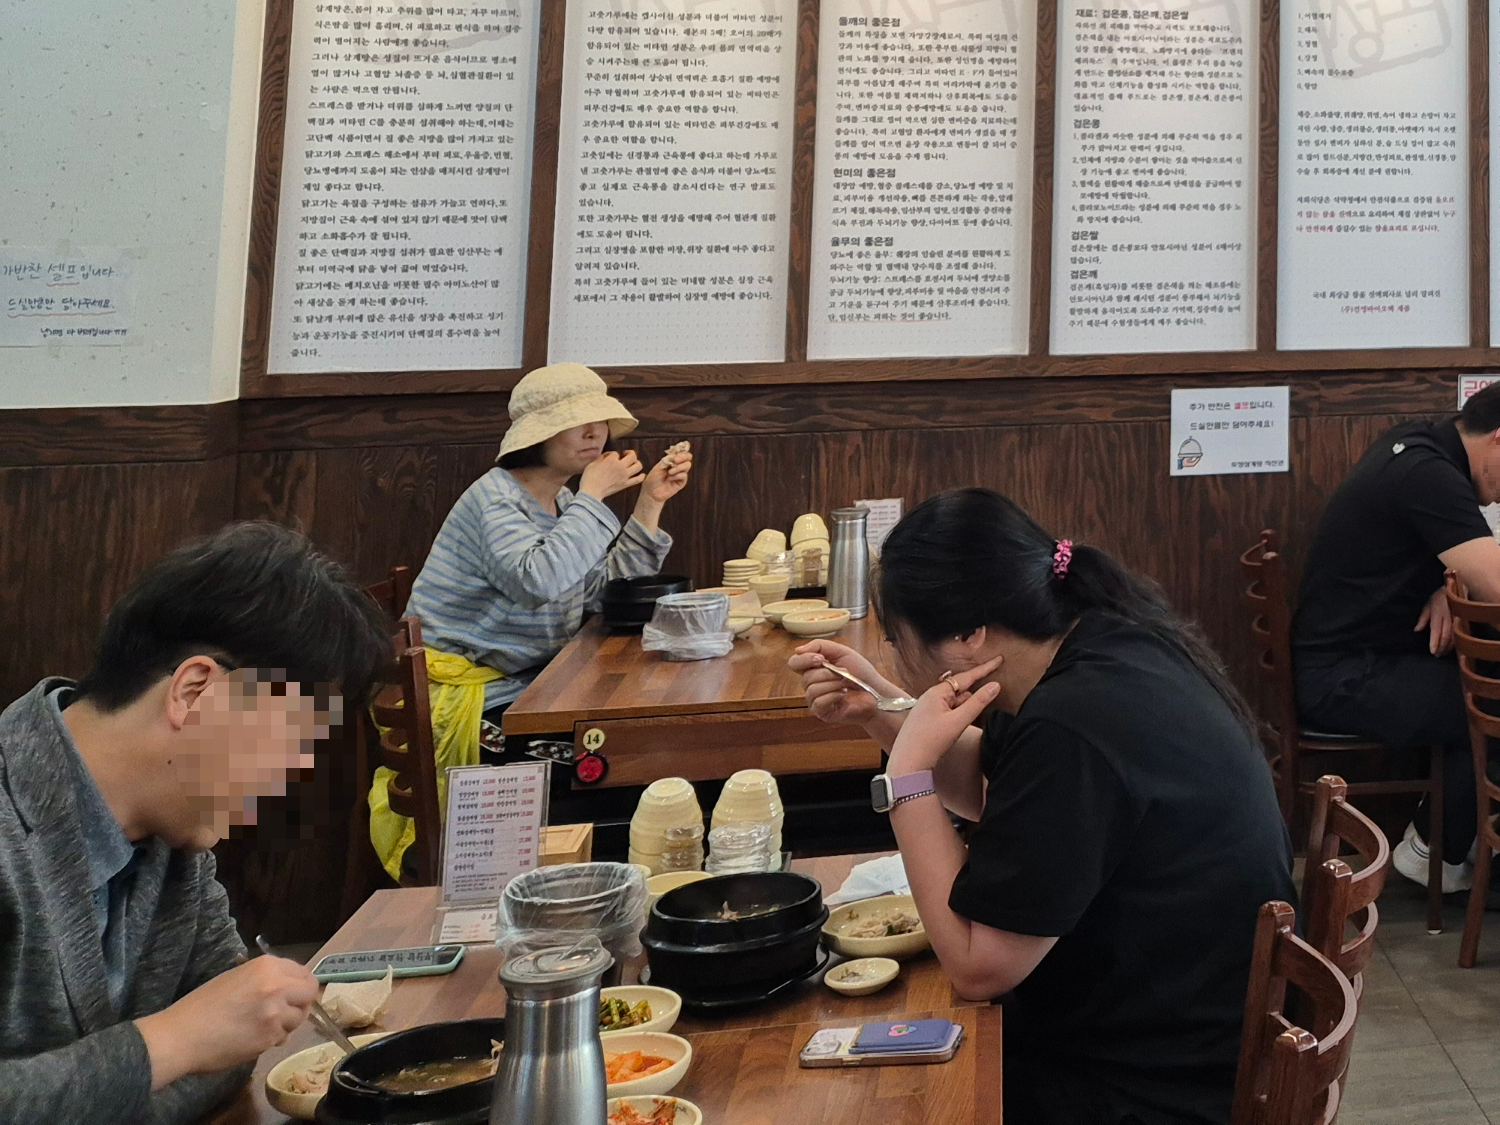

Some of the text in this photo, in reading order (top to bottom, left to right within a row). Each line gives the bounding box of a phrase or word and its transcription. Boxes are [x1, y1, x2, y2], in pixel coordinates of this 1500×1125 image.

[833, 168, 896, 178] 현미의 좋은점
[830, 237, 894, 247] 율무의 좋은점
